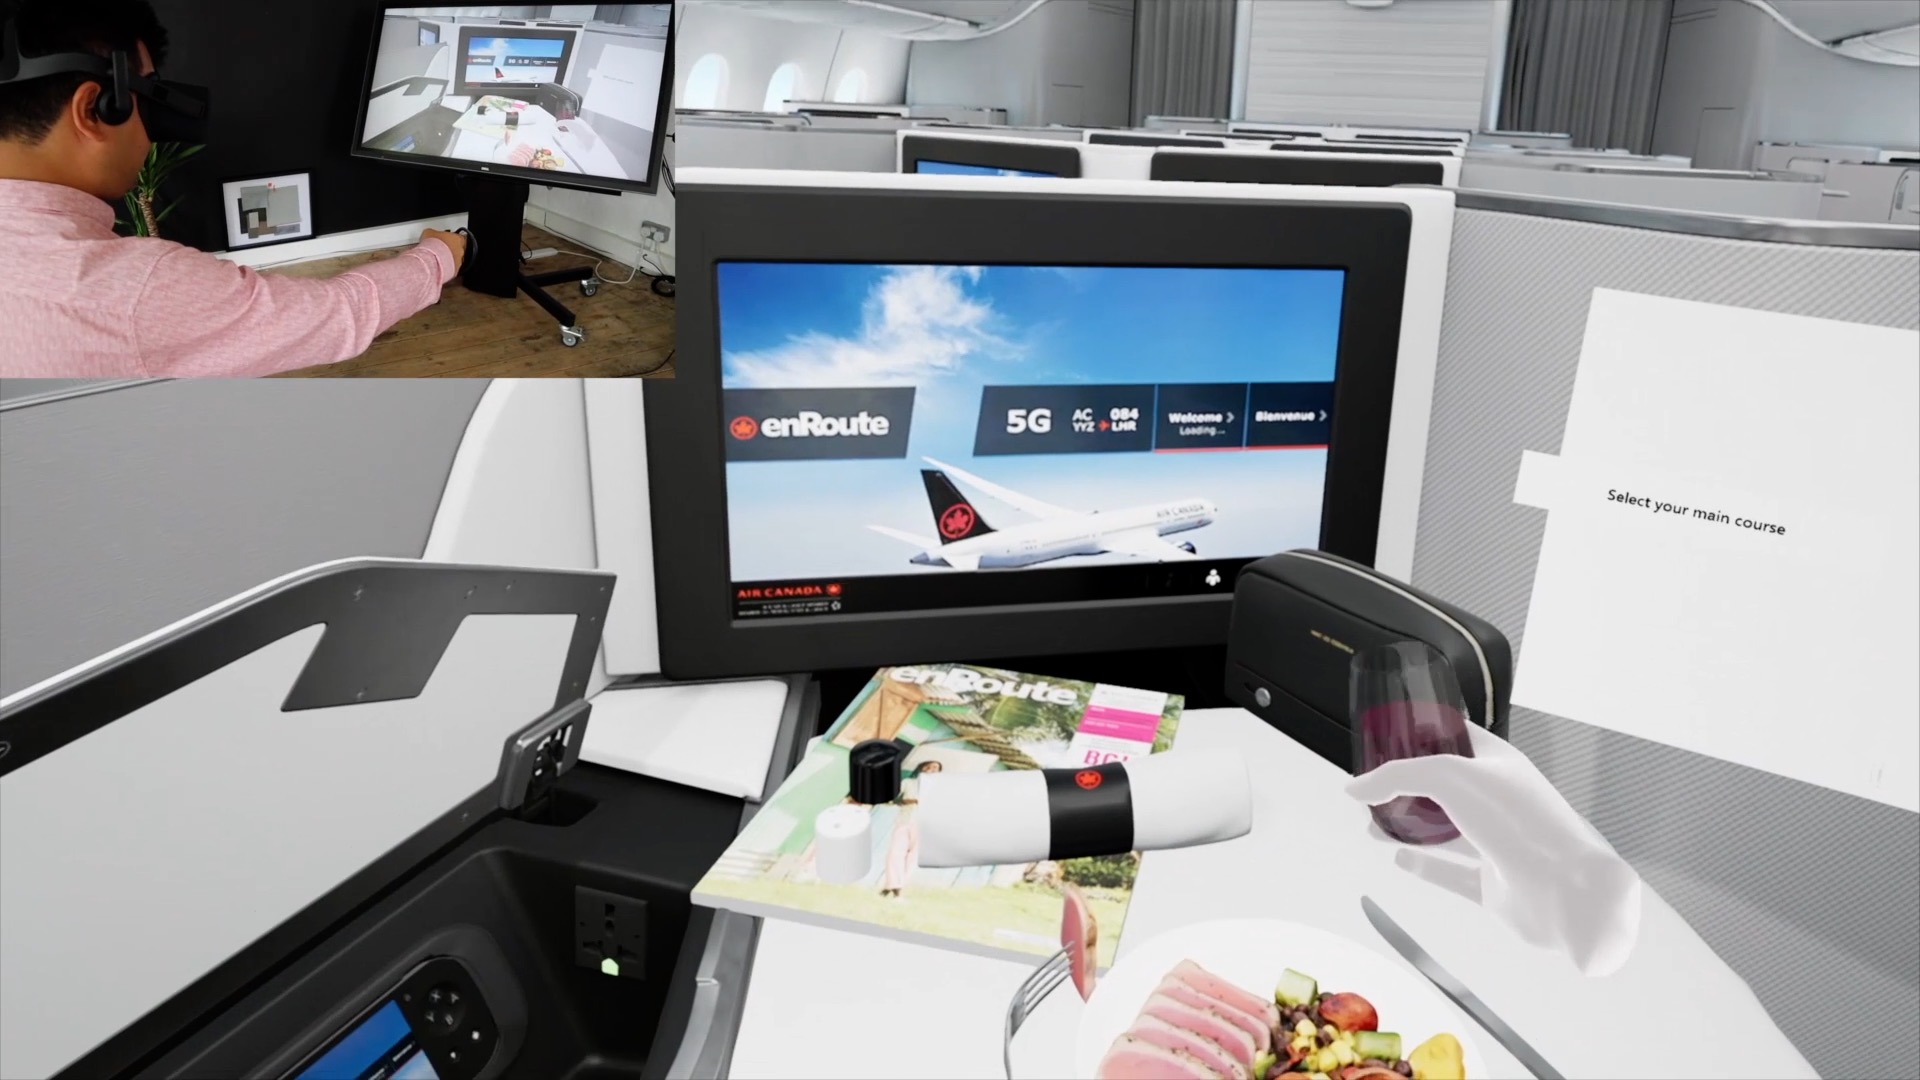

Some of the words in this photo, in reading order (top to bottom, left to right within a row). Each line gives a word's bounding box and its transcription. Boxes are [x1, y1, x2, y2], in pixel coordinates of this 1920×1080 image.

[1006, 408, 1052, 434] 5G
[1072, 408, 1093, 421] AC
[1109, 407, 1139, 420] 084
[1168, 411, 1223, 424] Welcome
[1255, 410, 1316, 422] Bienvenue
[760, 411, 890, 438] enRoute
[1072, 421, 1096, 432] YYZ
[1111, 420, 1137, 432] LHR
[1606, 489, 1651, 508] Select
[1653, 501, 1689, 516] your
[1692, 509, 1730, 524] main
[1734, 517, 1786, 536] course
[737, 589, 762, 598] AIR
[764, 585, 823, 597] CANADA
[884, 666, 1078, 706] enRoute
